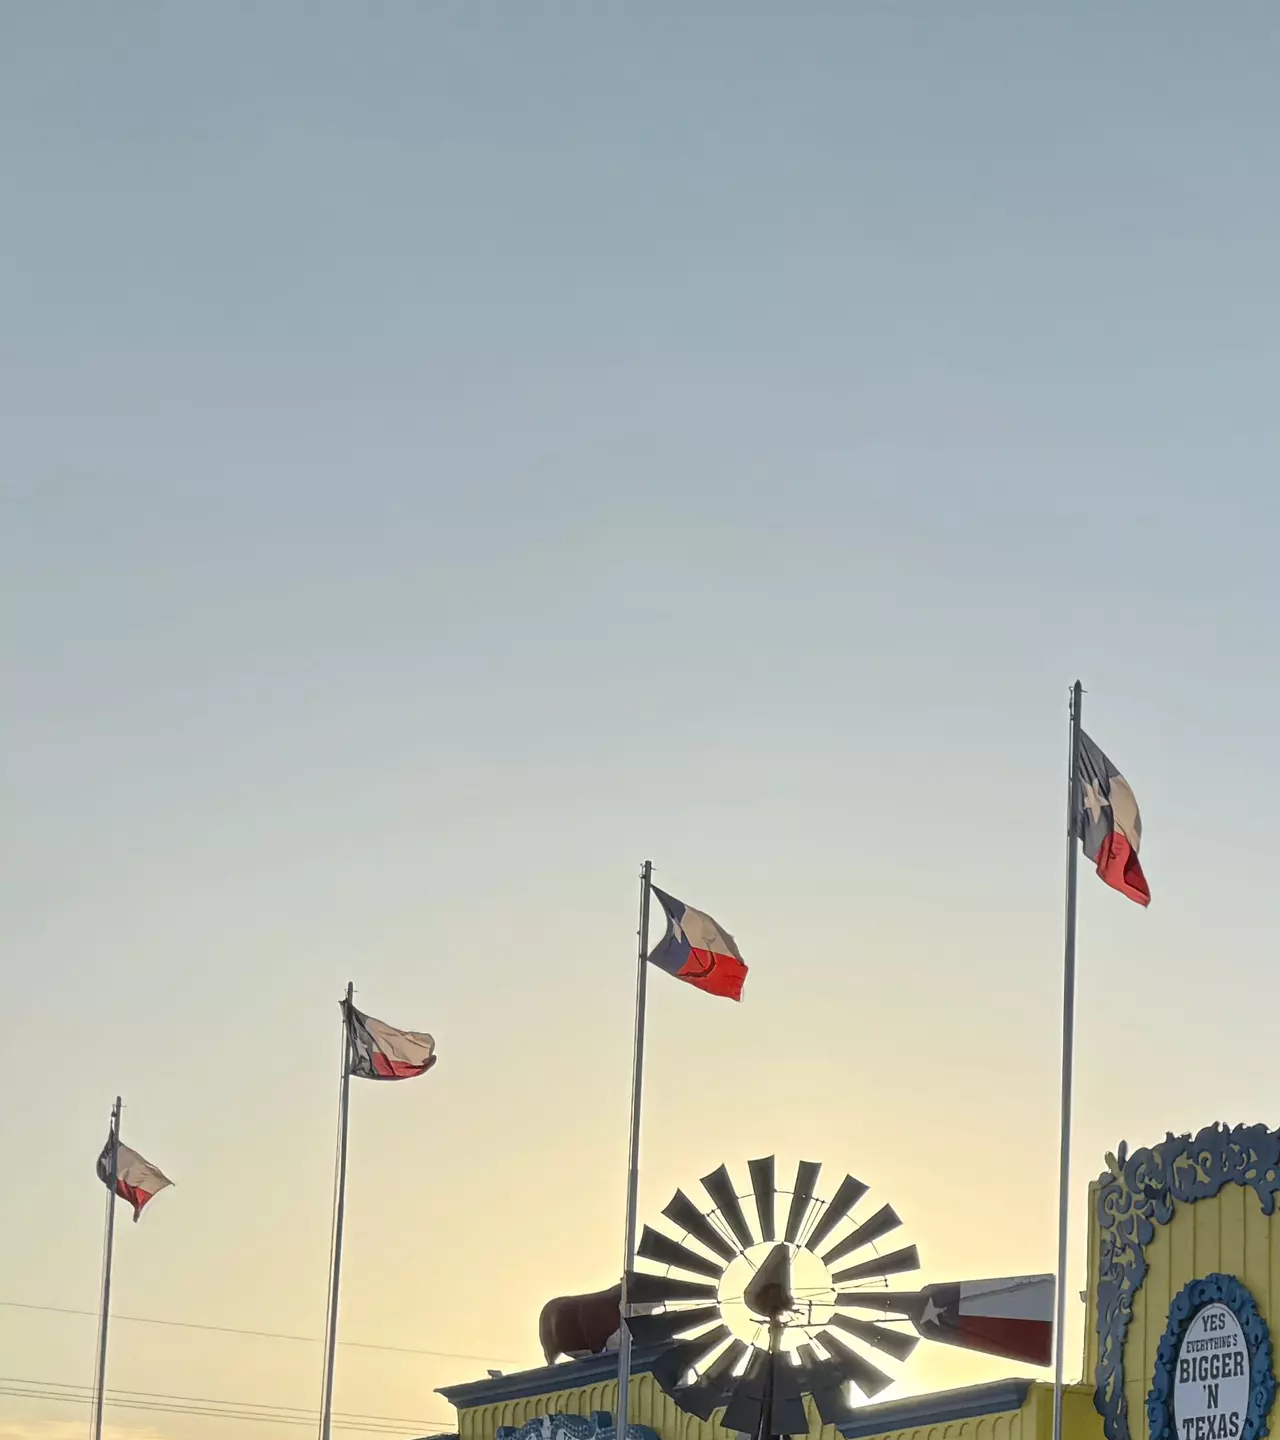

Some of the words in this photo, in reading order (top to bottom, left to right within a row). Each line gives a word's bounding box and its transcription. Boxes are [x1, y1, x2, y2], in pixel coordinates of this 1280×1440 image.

[1202, 1313, 1226, 1333] YES
[1186, 1334, 1238, 1353] EVERYTHING'S
[1179, 1351, 1244, 1384] BIGGER
[1203, 1383, 1219, 1409] 'N
